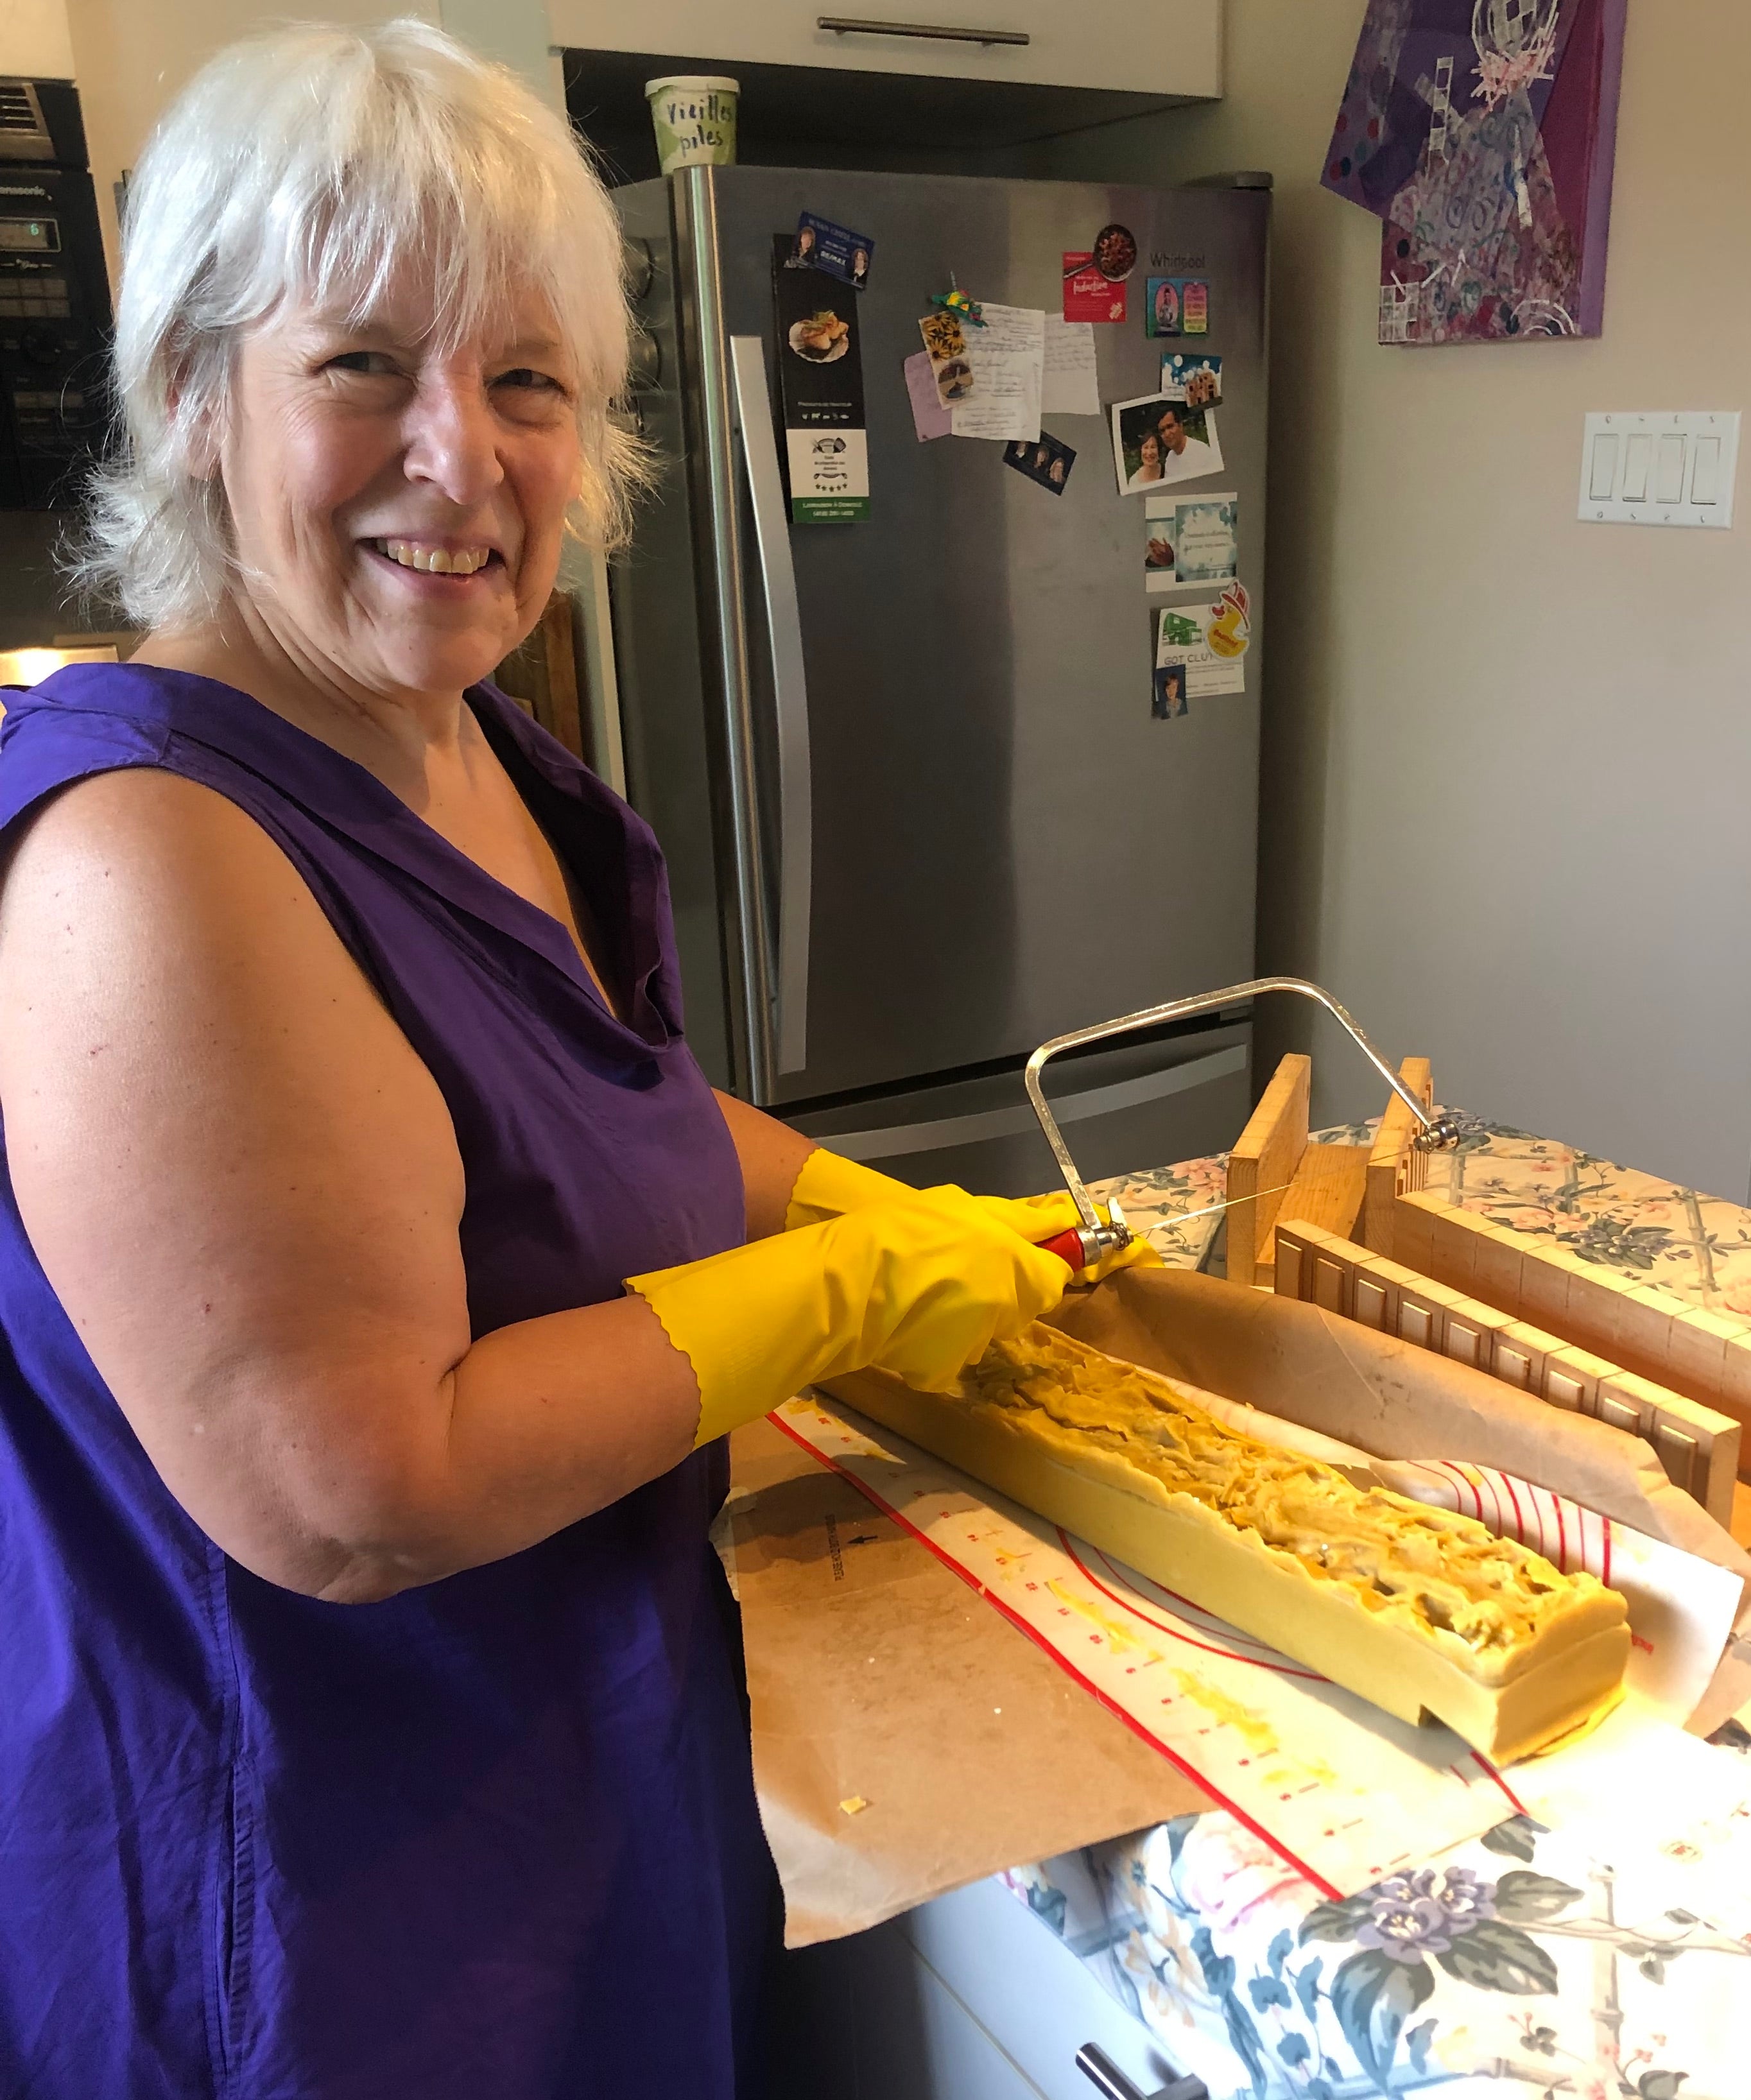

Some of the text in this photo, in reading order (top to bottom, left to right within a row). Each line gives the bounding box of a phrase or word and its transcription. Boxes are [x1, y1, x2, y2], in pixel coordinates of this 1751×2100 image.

[680, 124, 723, 158] piles
[30, 223, 39, 236] 6
[1150, 252, 1205, 269] Whirlpool
[1164, 655, 1184, 665] GOT
